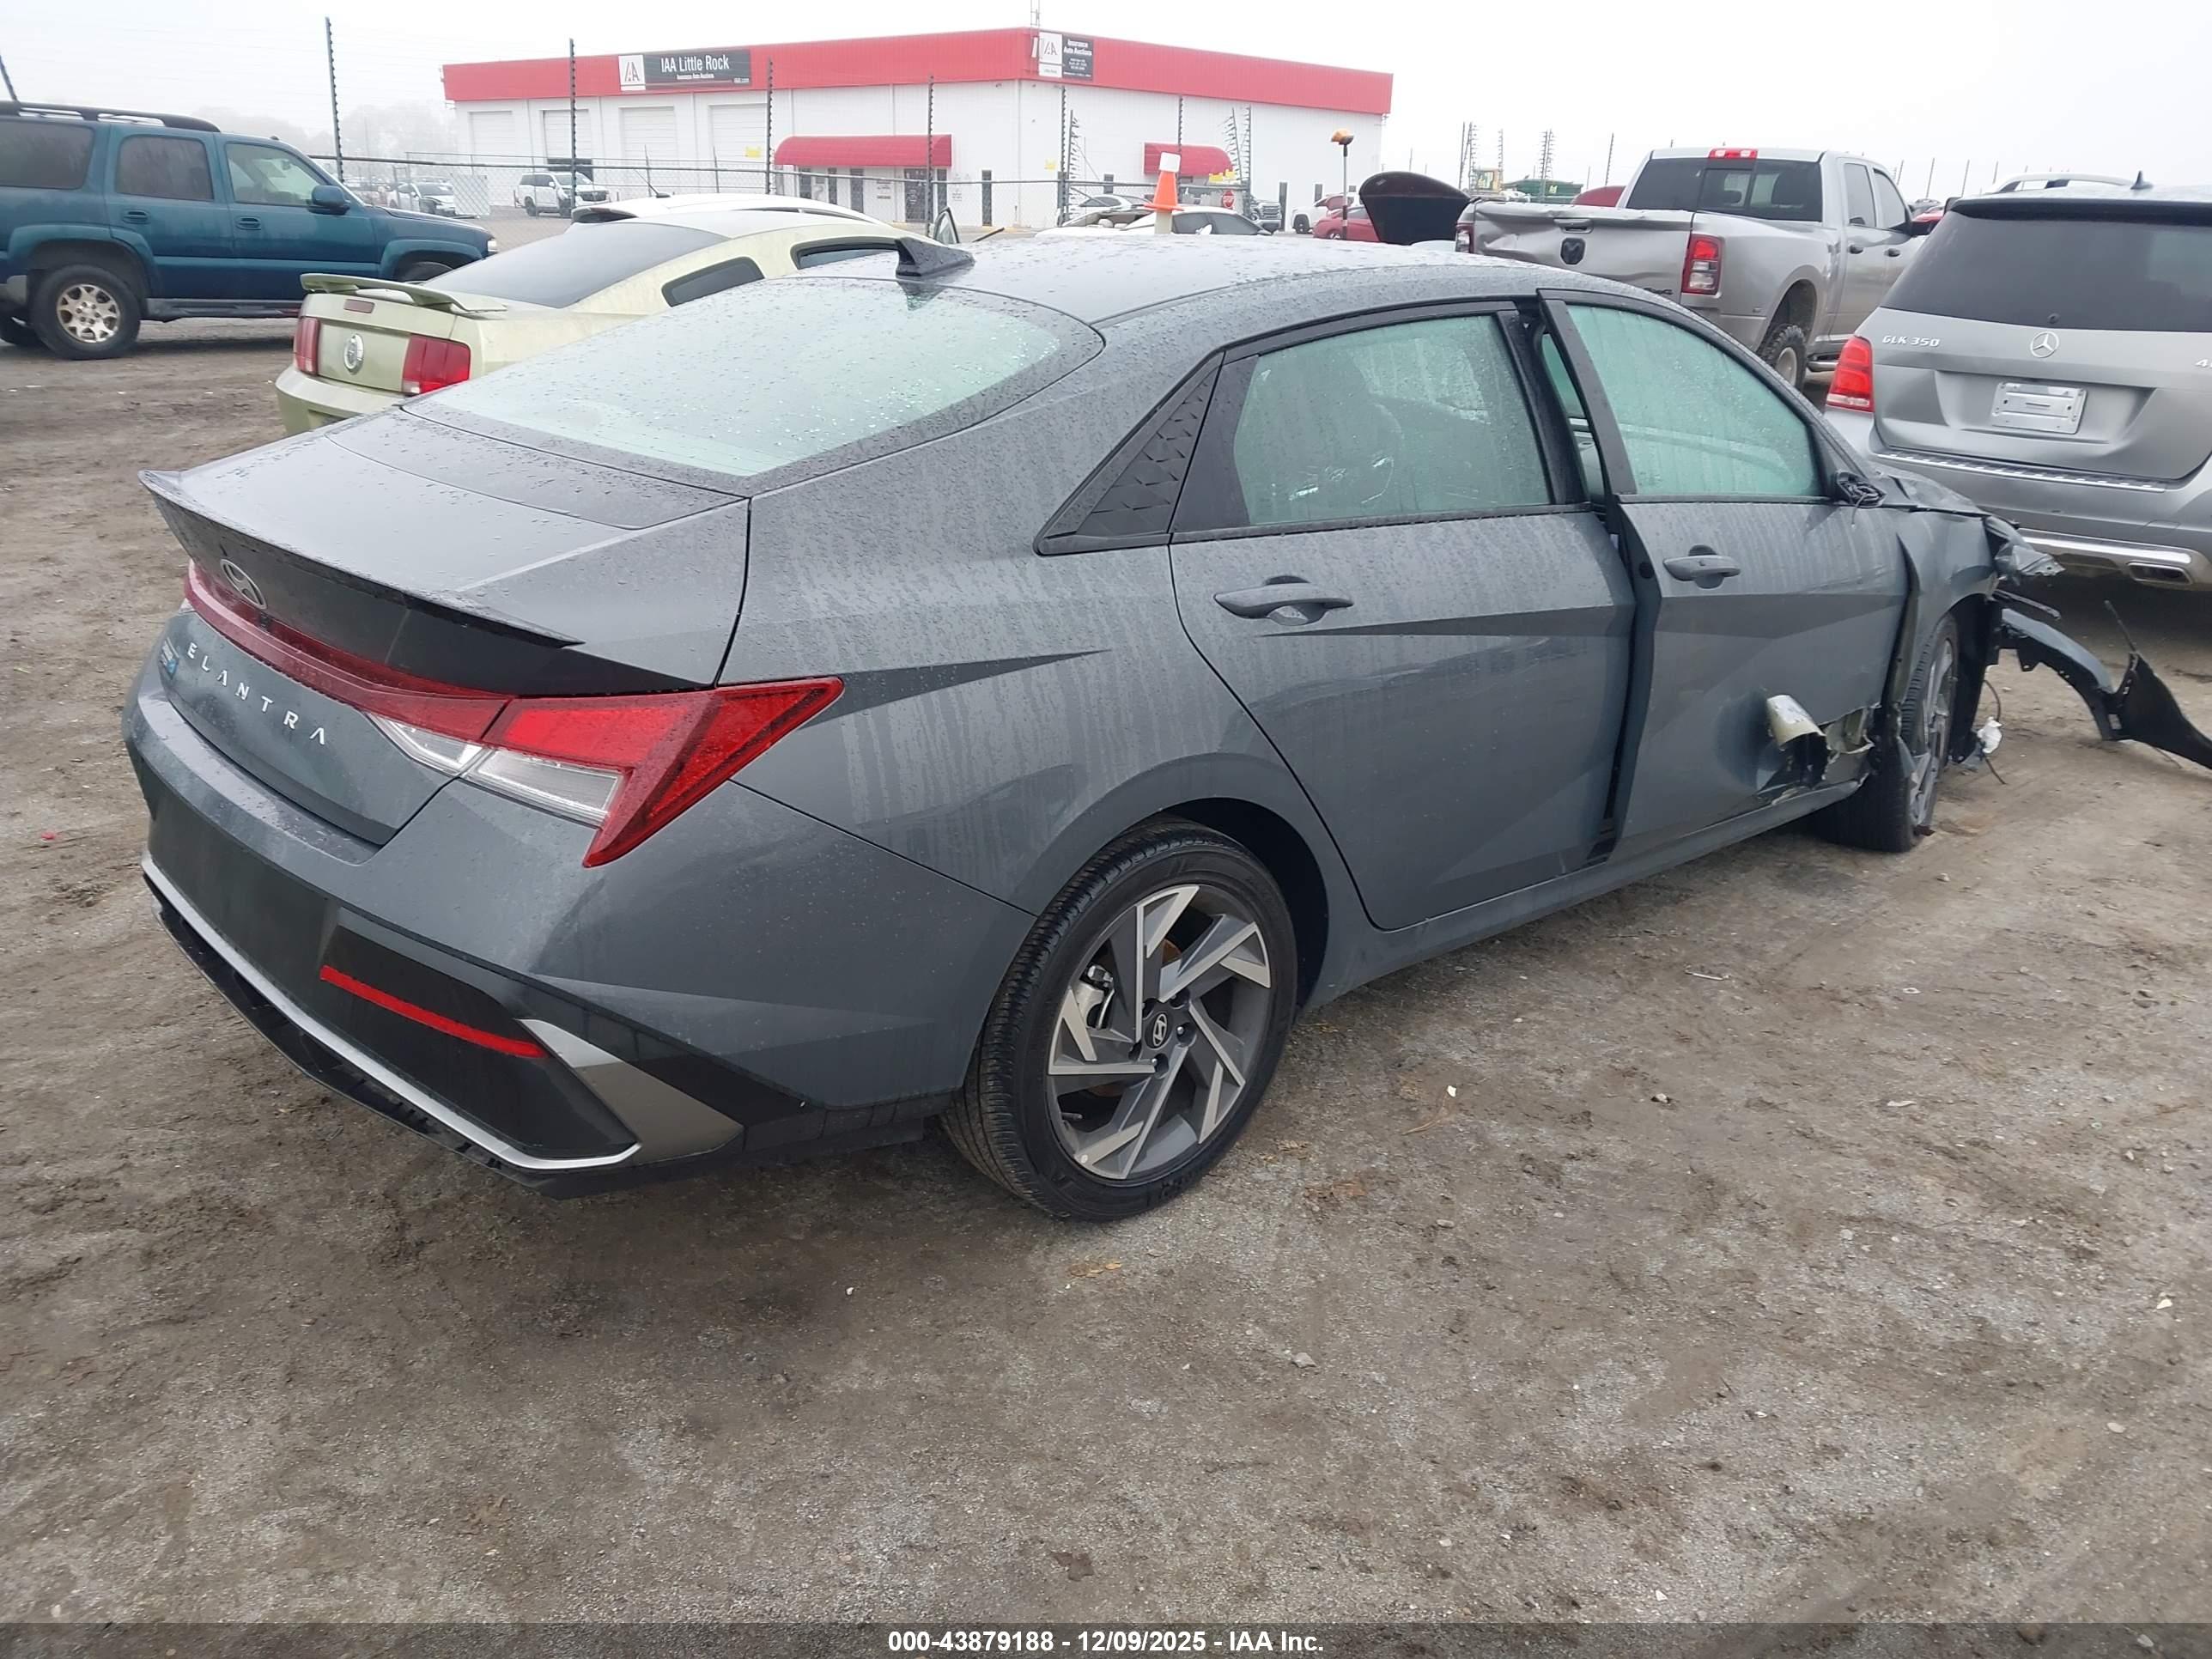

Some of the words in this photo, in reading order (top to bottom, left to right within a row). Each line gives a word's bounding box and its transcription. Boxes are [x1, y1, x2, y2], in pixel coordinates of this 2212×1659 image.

[660, 58, 677, 73] IAA
[678, 56, 702, 72] Little
[705, 54, 730, 70] Rock
[1881, 335, 1907, 344] GLK
[1910, 337, 1941, 347] 350
[186, 641, 326, 745] ELANTRA
